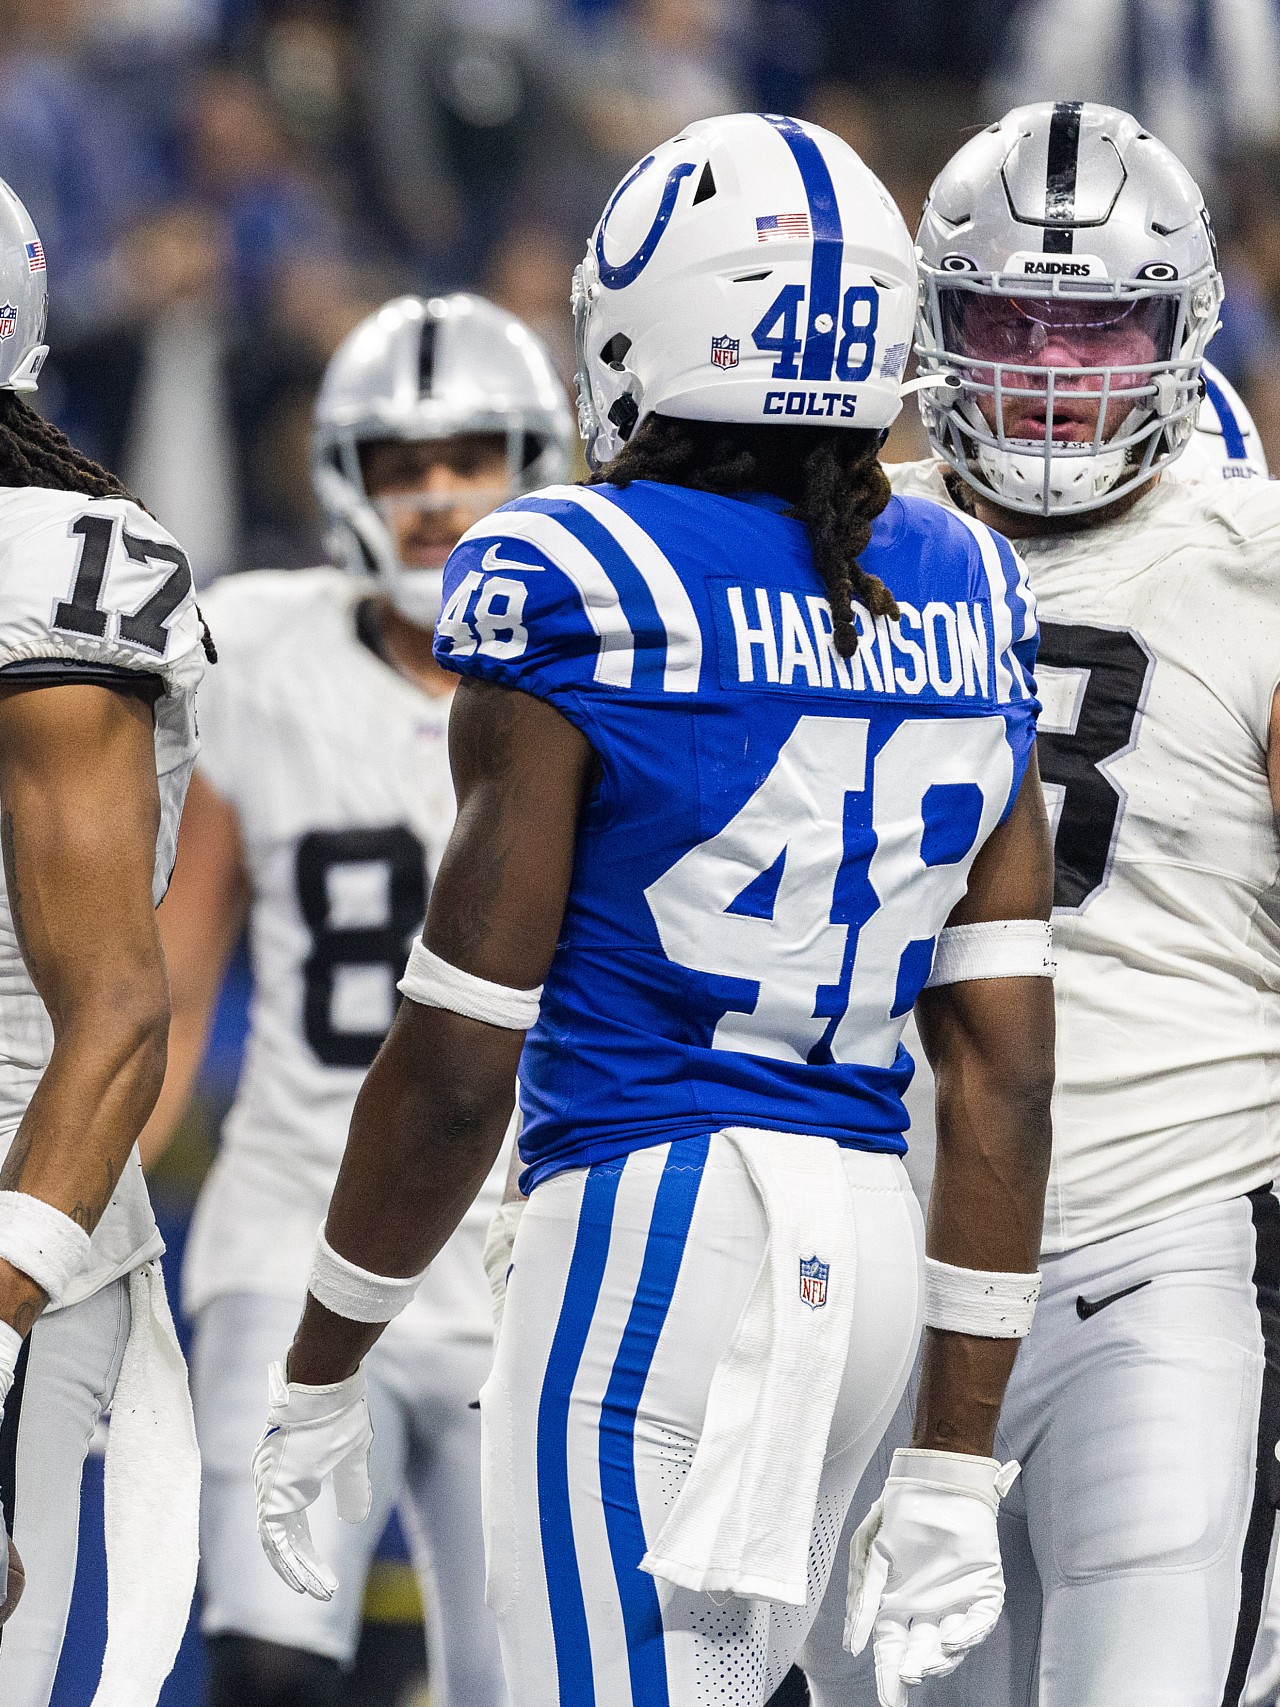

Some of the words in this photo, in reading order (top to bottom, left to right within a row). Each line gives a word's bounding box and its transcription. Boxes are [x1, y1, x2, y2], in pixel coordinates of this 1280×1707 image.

[1024, 261, 1090, 277] RAIDERS
[713, 349, 736, 366] NFL
[751, 284, 880, 382] 48
[762, 391, 858, 418] COLTS
[50, 512, 194, 660] 17
[437, 570, 529, 660] 48
[727, 586, 989, 698] HARRISON
[643, 715, 1014, 1068] 48
[802, 1278, 824, 1304] NFL
